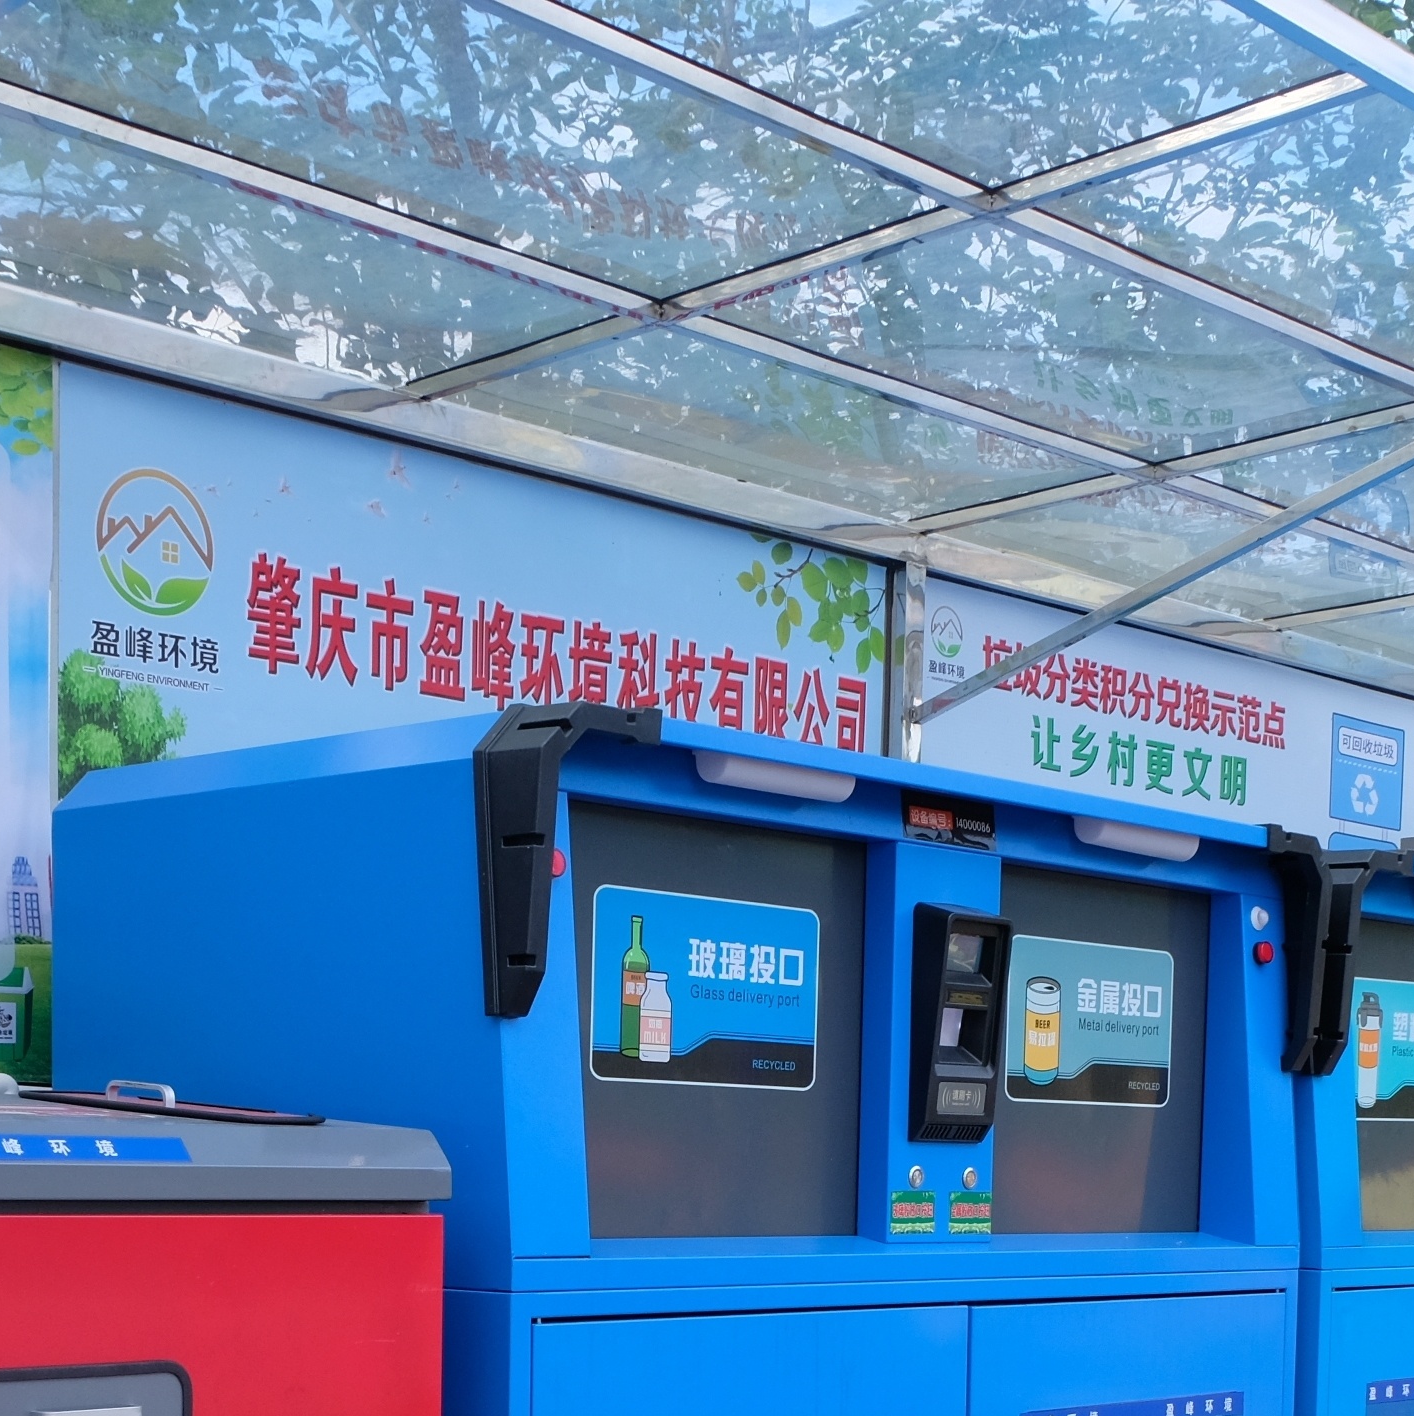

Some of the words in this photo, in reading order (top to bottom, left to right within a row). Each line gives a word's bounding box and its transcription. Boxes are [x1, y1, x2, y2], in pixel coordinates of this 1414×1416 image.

[91, 620, 219, 674] 盈峰环境
[247, 551, 869, 753] 肇庆市盈峰环境科技有限公司
[98, 666, 145, 682] YINGFENG
[147, 674, 210, 692] ENVIRONMENT
[928, 659, 966, 680] 盈峰环境
[1342, 732, 1395, 761] 可回收垃圾
[1030, 715, 1248, 806] 让乡村更文明
[688, 938, 804, 987] 玻璃投口
[690, 984, 725, 1001] Glass
[728, 988, 774, 1009] delivery
[777, 994, 800, 1009] port
[1077, 978, 1163, 1018] 金属投口
[1035, 1019, 1051, 1029] BEER
[1078, 1017, 1103, 1032] Metal
[1105, 1020, 1140, 1038] delivery
[1142, 1025, 1160, 1039] port
[643, 1031, 667, 1044] MILK
[1391, 1045, 1414, 1058] Plastic
[752, 1059, 796, 1071] RECYCLED
[1128, 1081, 1161, 1091] RECYCLED
